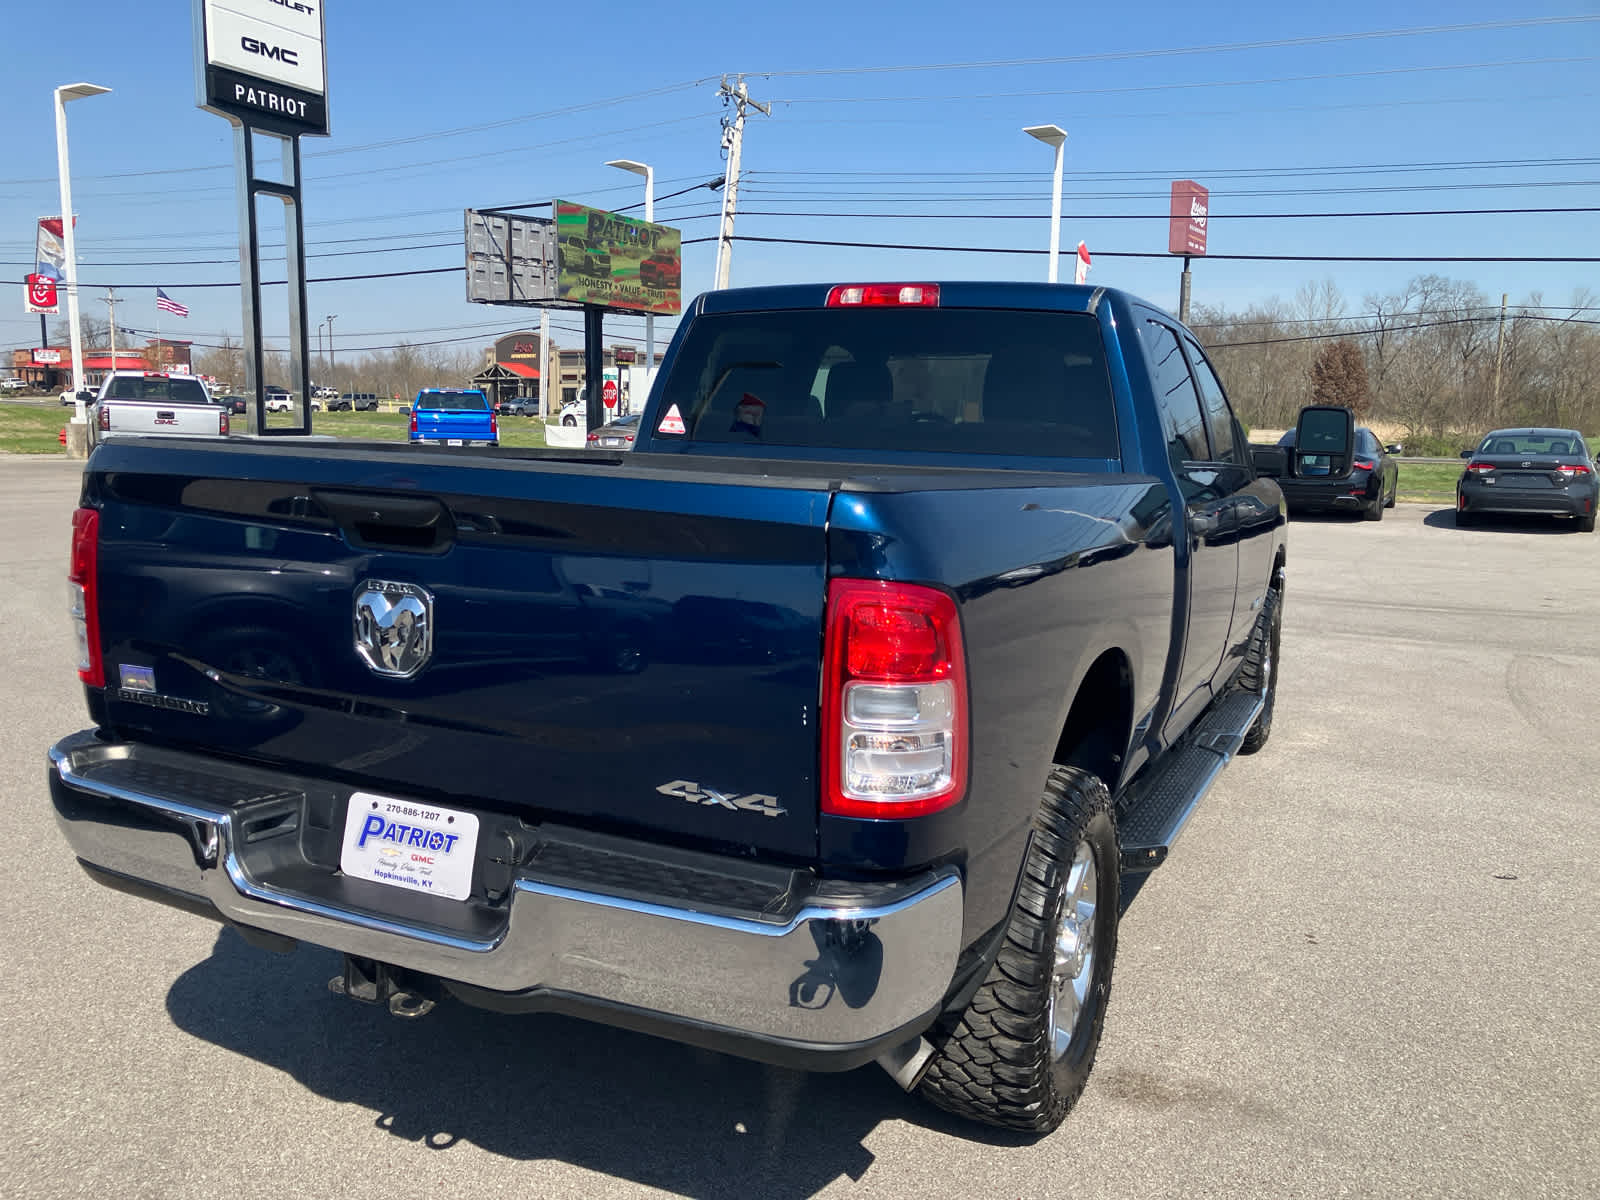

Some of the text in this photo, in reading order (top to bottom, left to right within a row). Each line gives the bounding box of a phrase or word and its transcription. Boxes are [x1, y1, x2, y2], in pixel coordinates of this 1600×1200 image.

[241, 36, 298, 66] GMC
[235, 84, 306, 117] PATRIOT
[588, 212, 660, 249] PATRIOT
[578, 277, 613, 291] HONESTY
[619, 285, 641, 296] VALUE
[647, 290, 666, 299] TRUST
[603, 388, 617, 399] STOP
[367, 580, 415, 594] RAM
[386, 803, 441, 821] 270-886-1207
[358, 815, 459, 853] PATRIOT
[411, 853, 435, 865] GMC
[374, 868, 433, 888] Hopkinsville, KY
